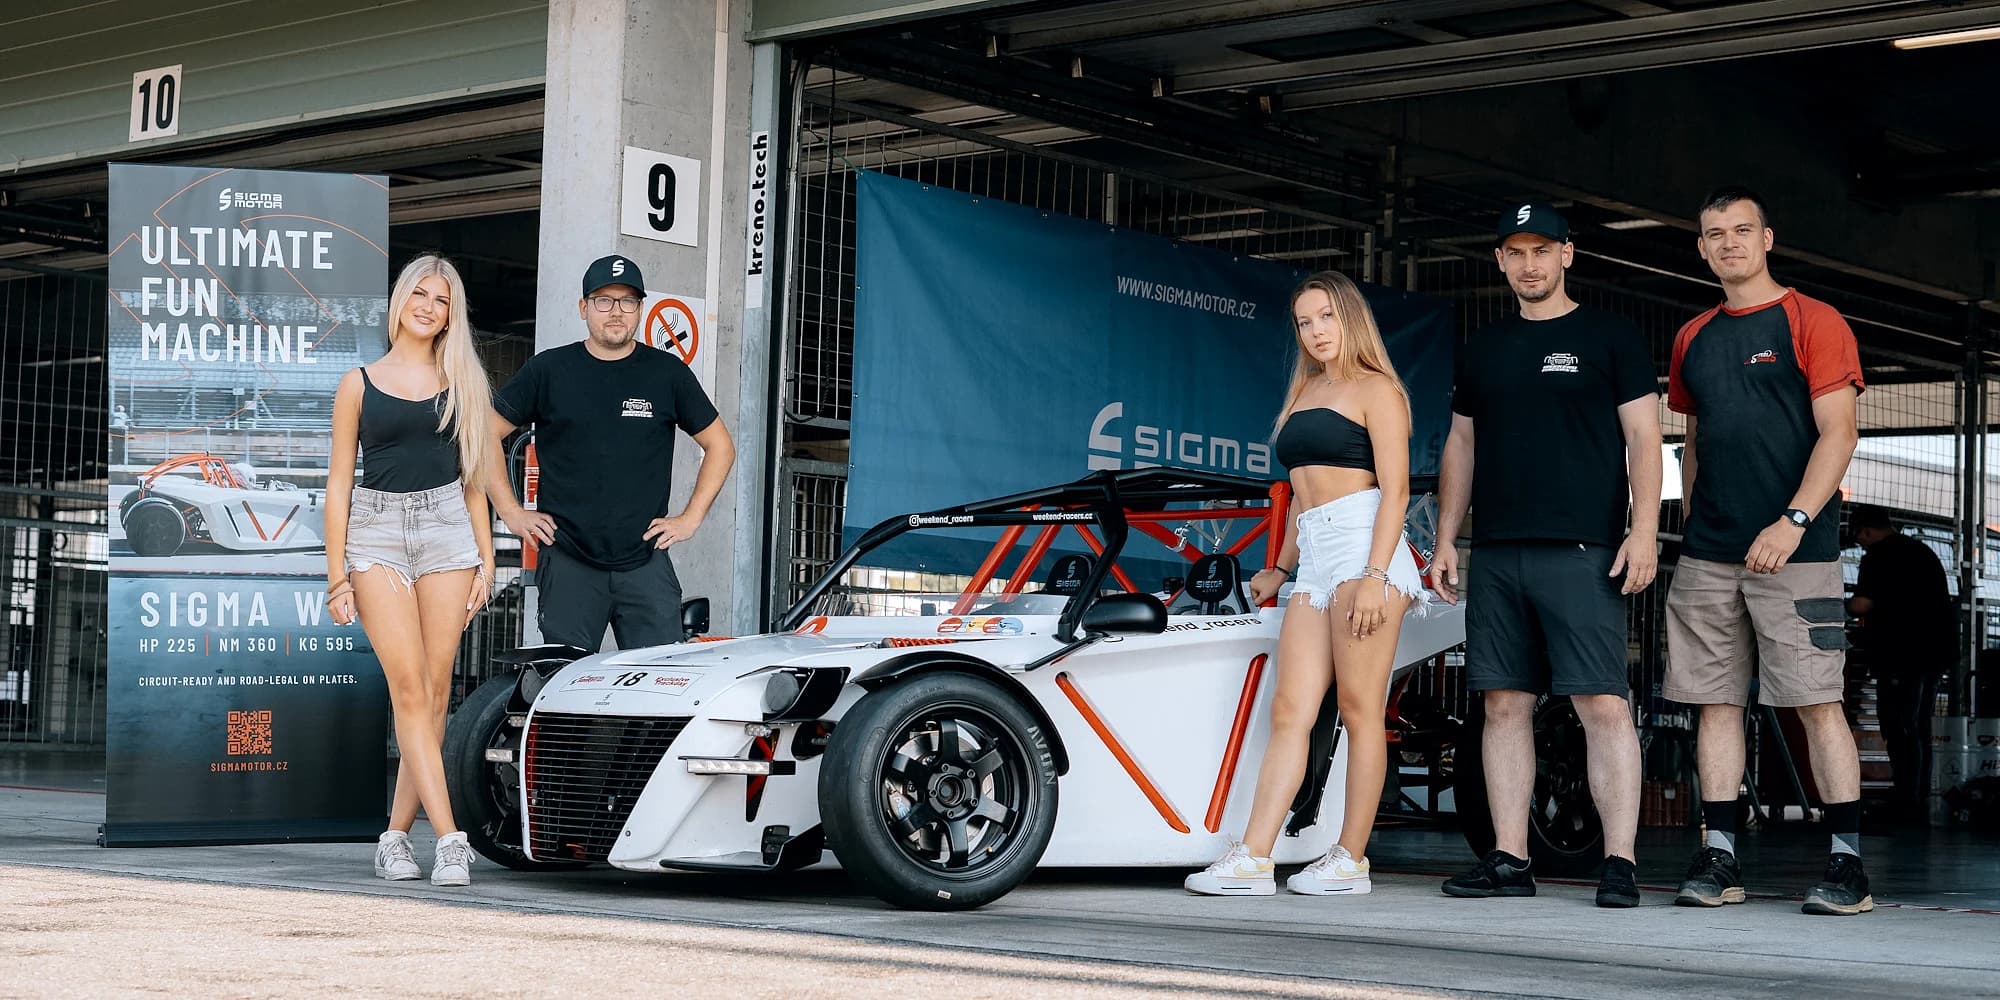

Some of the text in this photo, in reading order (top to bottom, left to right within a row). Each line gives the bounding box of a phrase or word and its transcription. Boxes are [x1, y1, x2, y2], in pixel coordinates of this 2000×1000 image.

[139, 74, 176, 132] 10
[647, 162, 676, 232] 9
[747, 134, 768, 276] kreno.tech
[141, 225, 333, 270] ULTIMATE
[141, 276, 218, 317] FUN
[1117, 275, 1257, 320] WWW.SIGMAMOTOR.CZ
[141, 322, 318, 364] MACHINE
[908, 514, 974, 527] @weekend_racers
[140, 591, 270, 628] SIGMA
[1164, 617, 1262, 633] end_racers
[139, 637, 353, 653] HP 225 NM 360 KG 595
[138, 674, 358, 687] CIRCUIT-READY AND ROAD-LEGAL ON PLATES.
[612, 671, 649, 687] 18
[210, 761, 289, 772] SIGMAMOTOR.CZ
[1026, 725, 1057, 785] AVON
